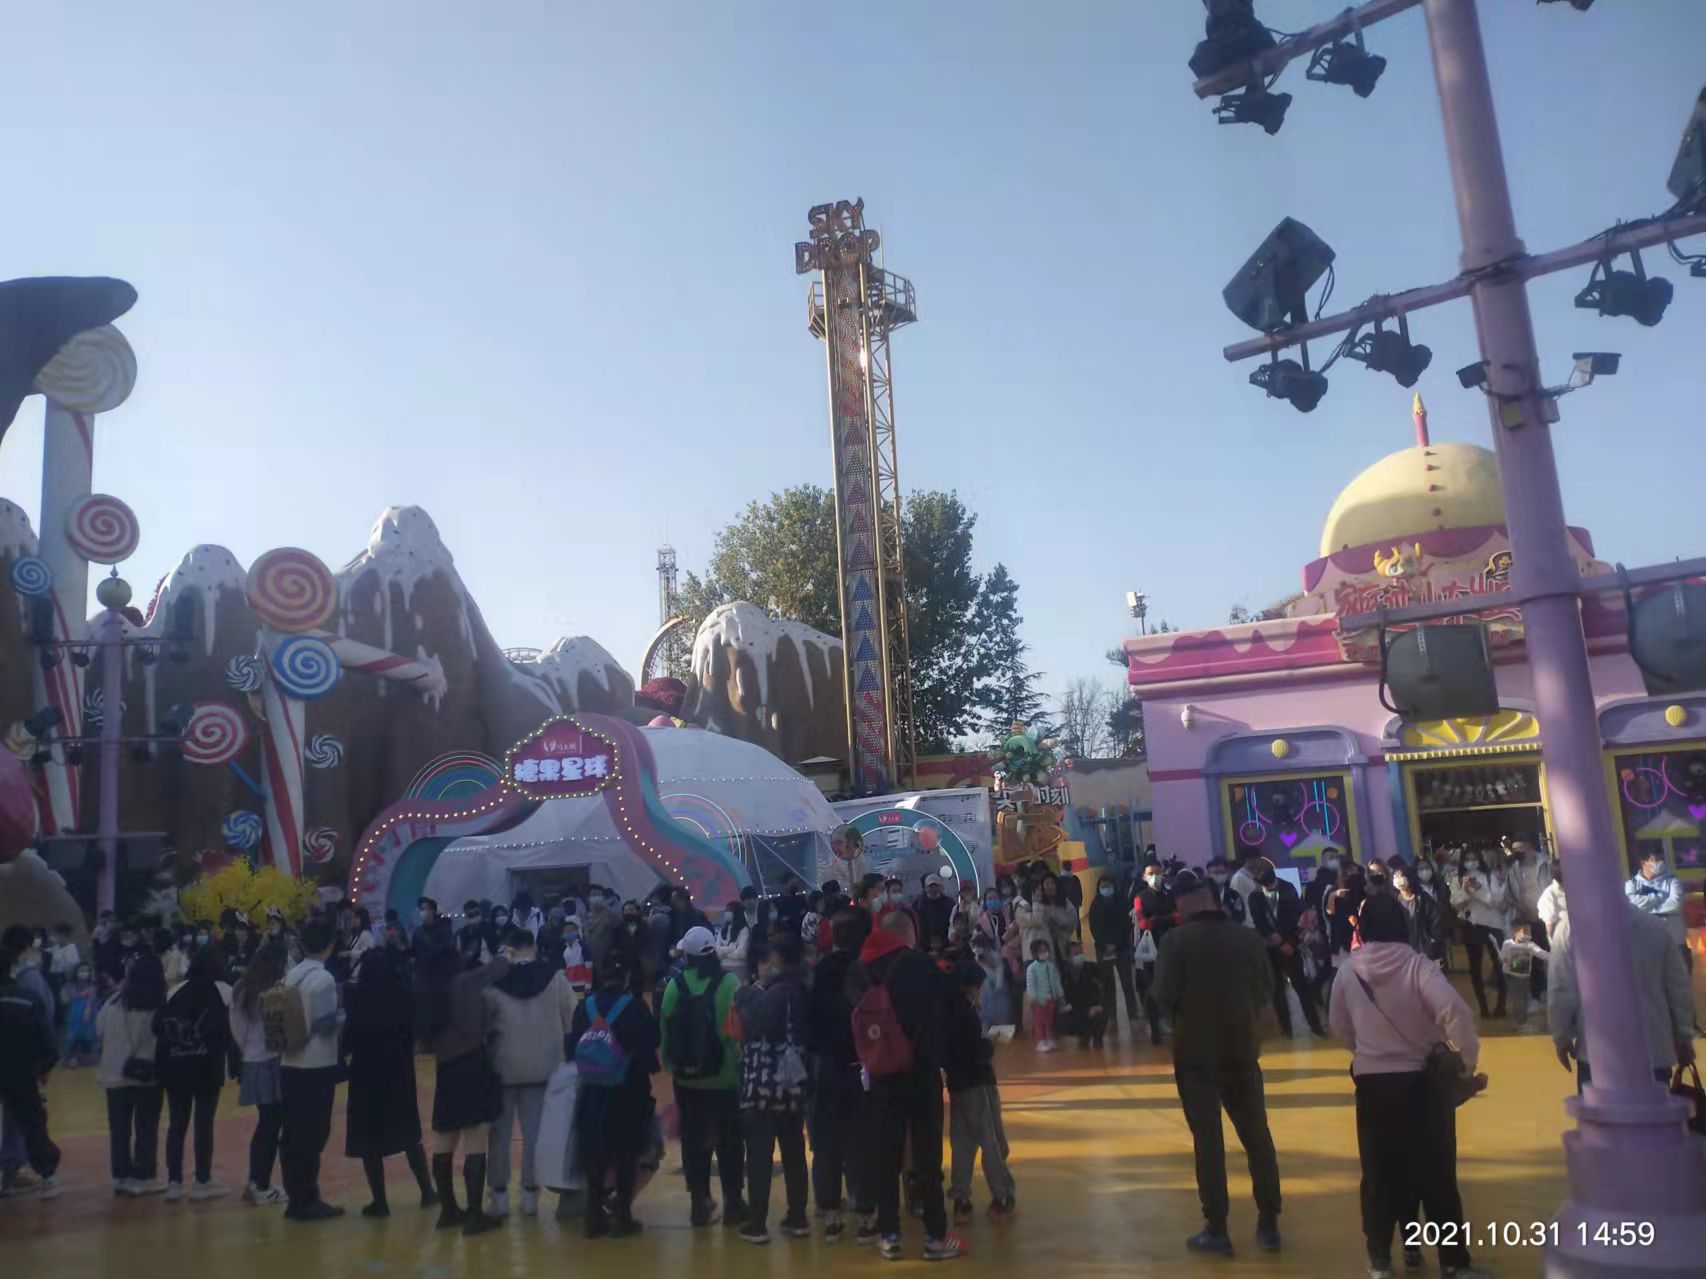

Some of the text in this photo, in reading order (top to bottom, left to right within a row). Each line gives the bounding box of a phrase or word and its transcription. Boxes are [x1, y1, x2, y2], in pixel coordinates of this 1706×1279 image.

[795, 229, 880, 275] DROP
[514, 755, 608, 782] 糖果星球
